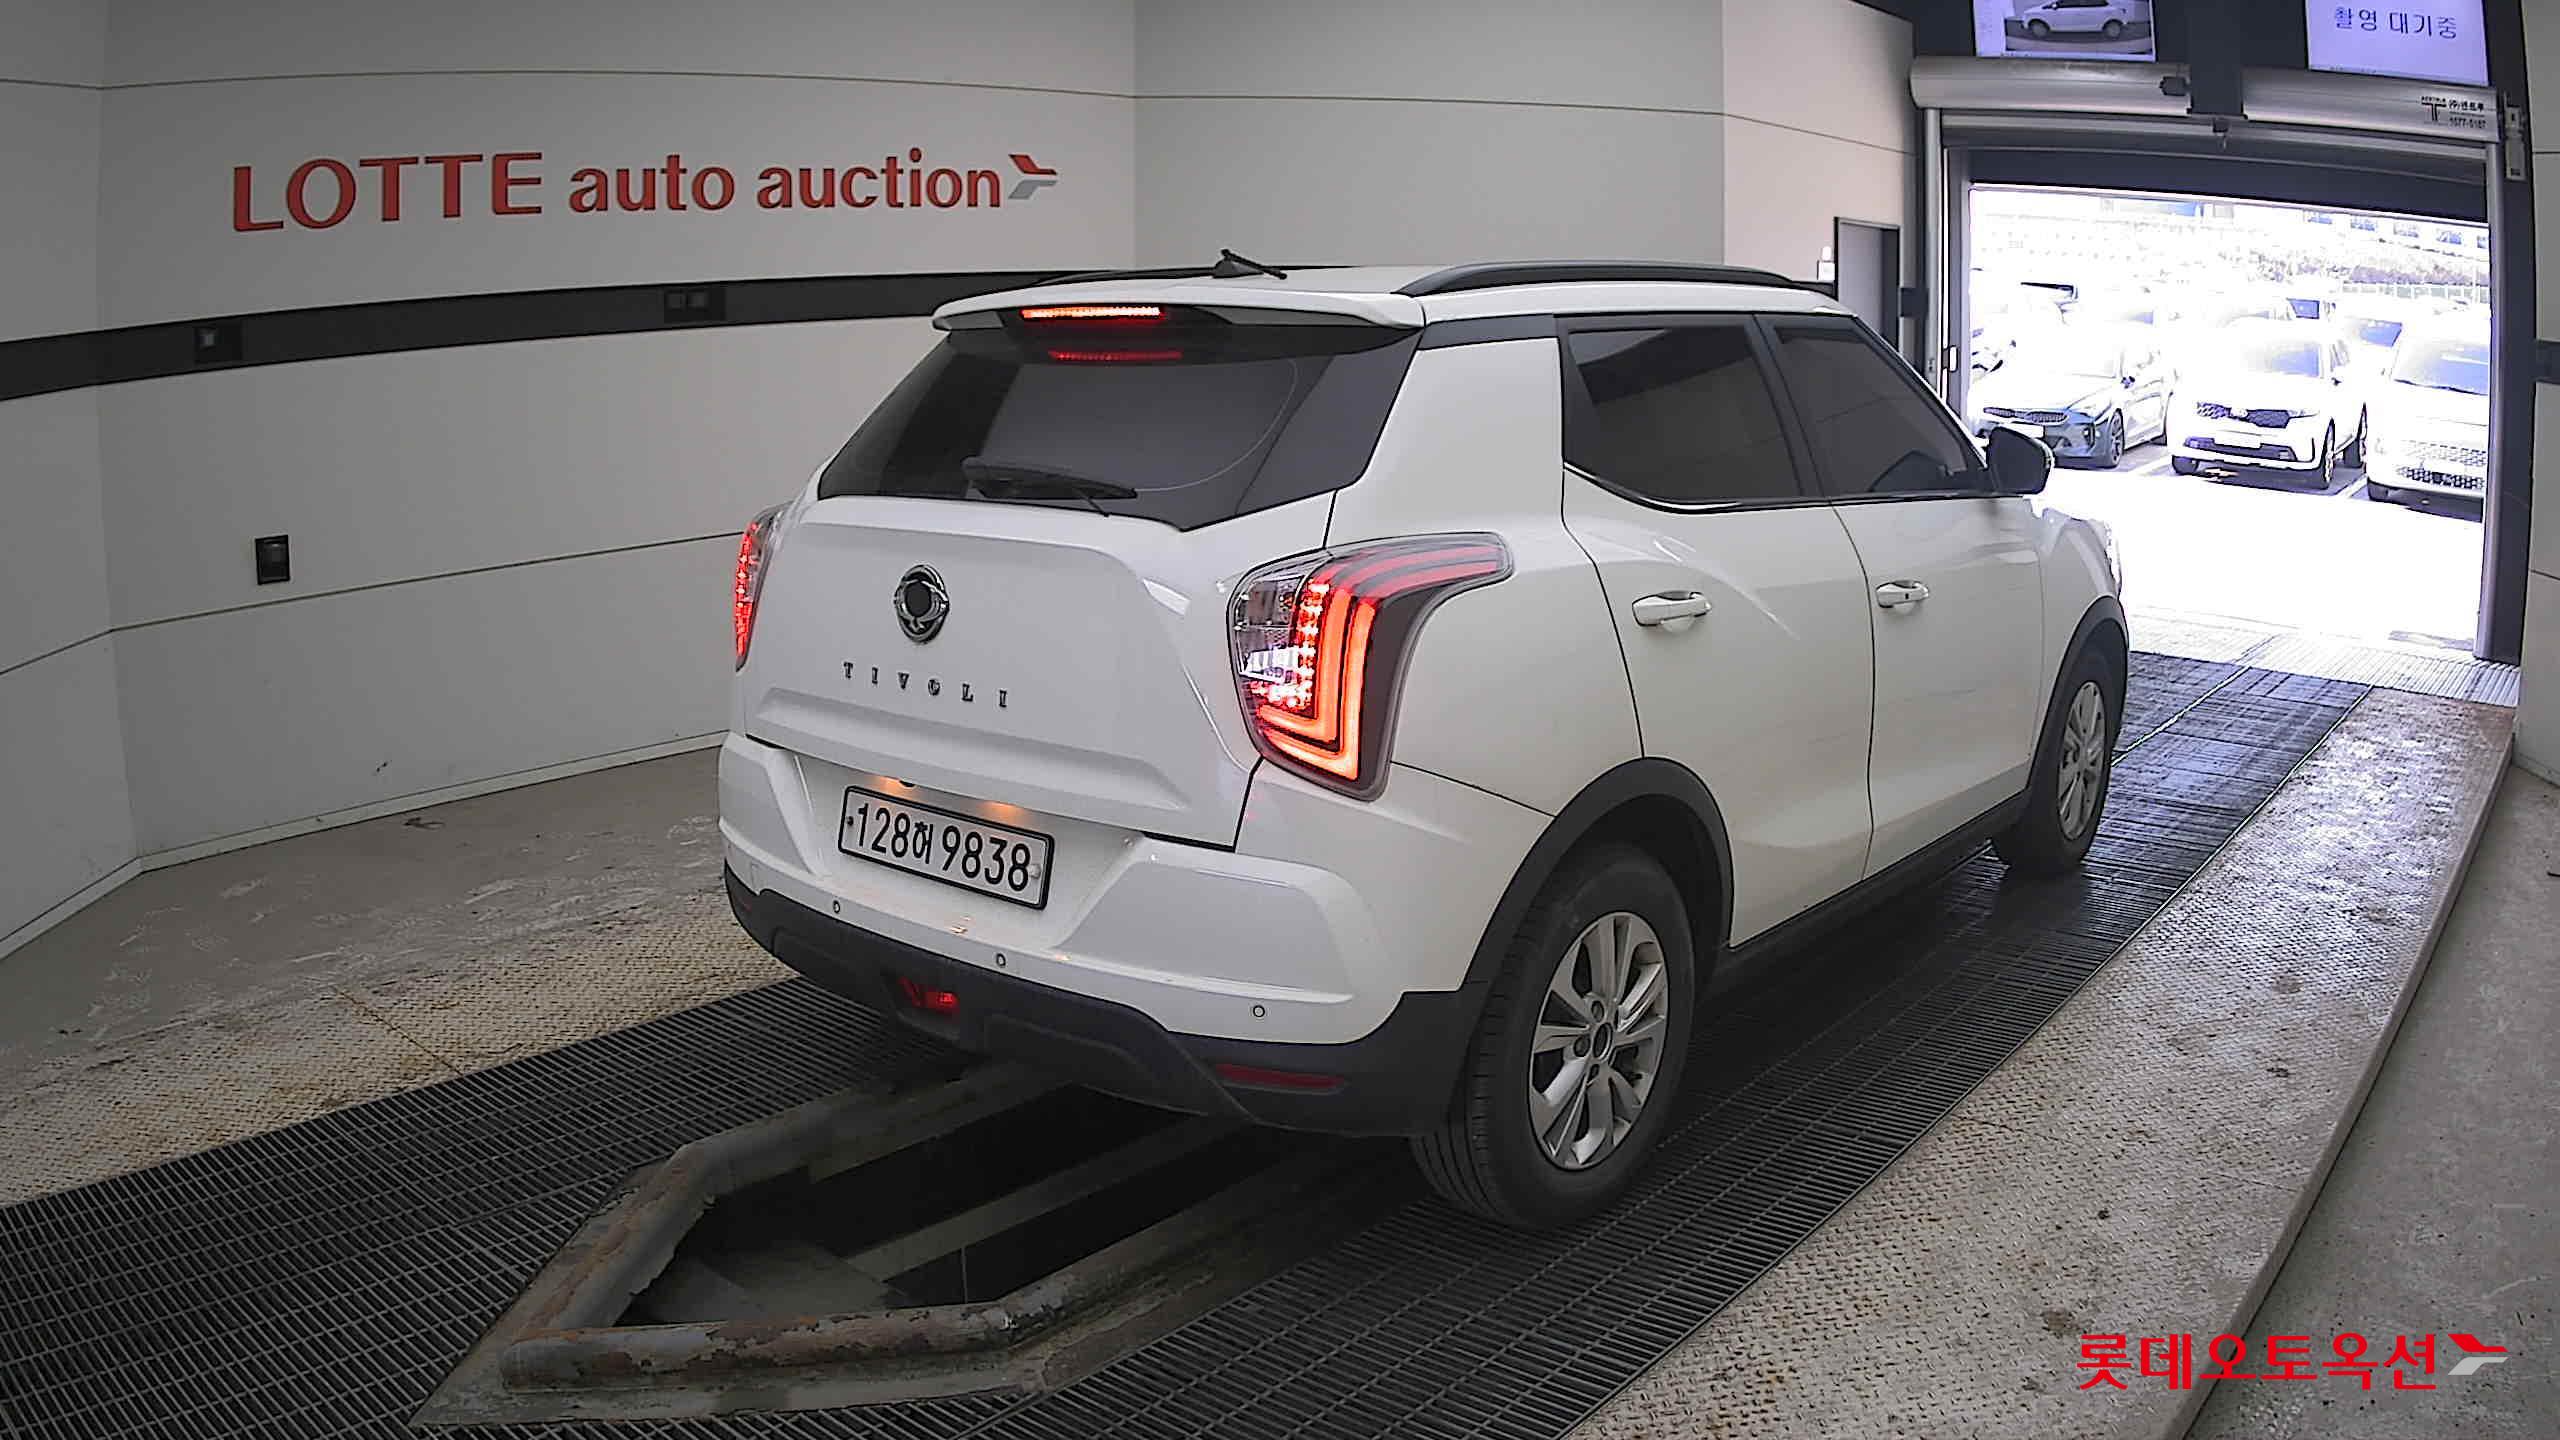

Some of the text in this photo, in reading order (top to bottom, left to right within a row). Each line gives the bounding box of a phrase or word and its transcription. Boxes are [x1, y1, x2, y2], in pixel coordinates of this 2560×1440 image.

[2335, 6, 2457, 39] 촬영 대기중
[232, 148, 1001, 232] LOTTE auto auction
[843, 661, 1008, 708] TIVOLI
[857, 802, 1032, 892] 128허 9838
